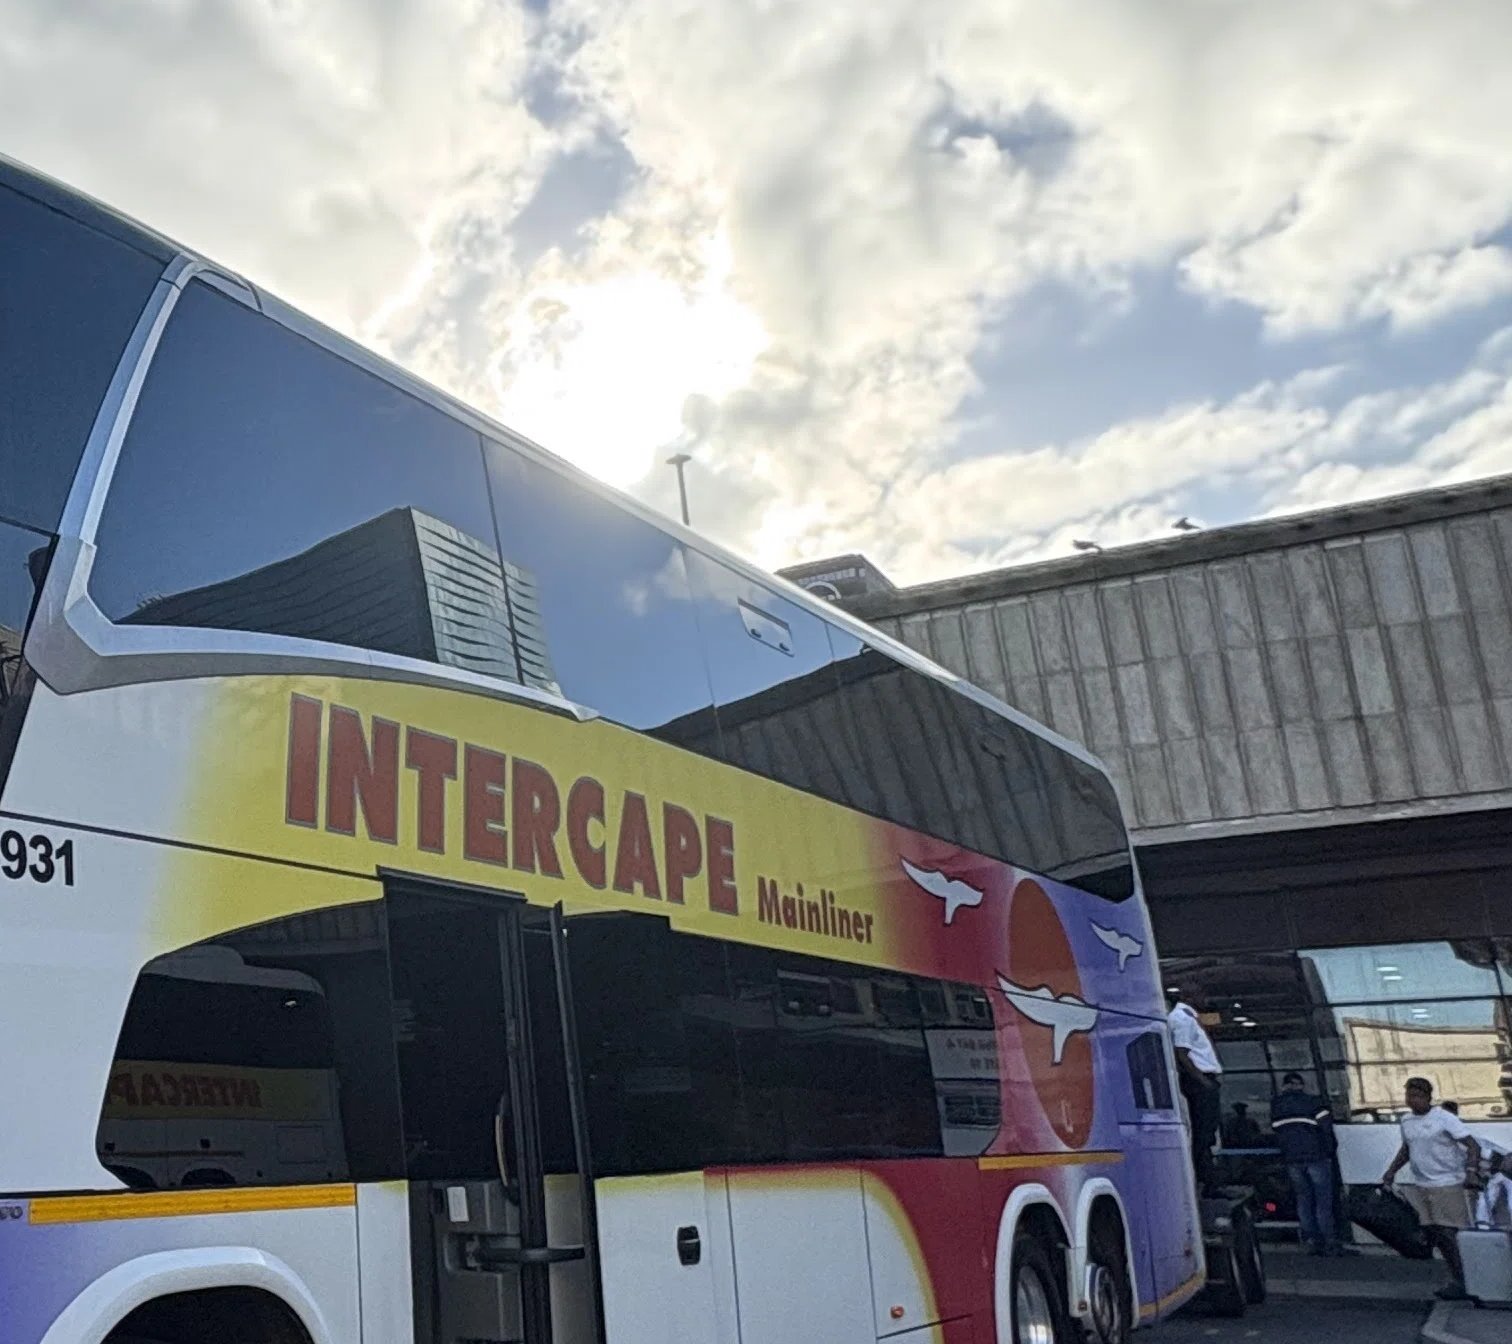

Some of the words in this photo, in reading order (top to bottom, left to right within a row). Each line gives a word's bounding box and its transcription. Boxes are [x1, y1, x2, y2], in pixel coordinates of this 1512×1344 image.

[0, 829, 74, 887] 931
[285, 691, 739, 916] INTERCAPE
[757, 876, 873, 944] Mainliner
